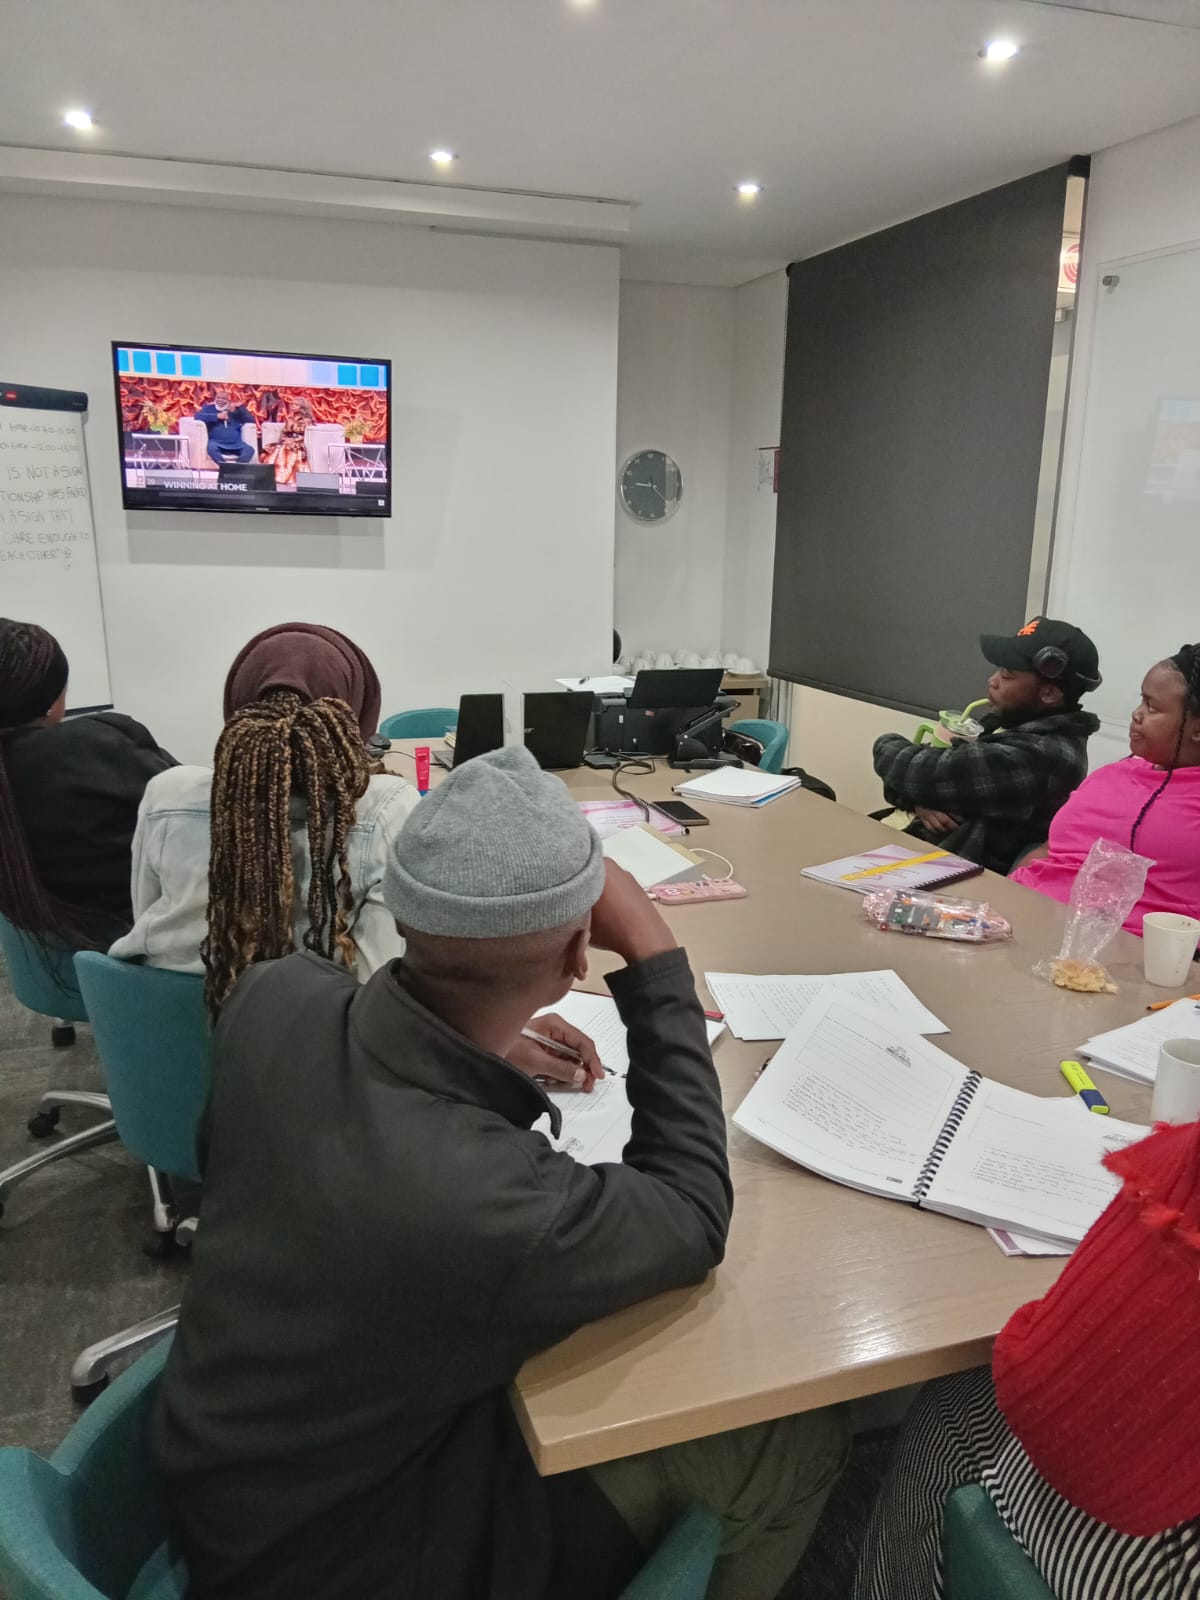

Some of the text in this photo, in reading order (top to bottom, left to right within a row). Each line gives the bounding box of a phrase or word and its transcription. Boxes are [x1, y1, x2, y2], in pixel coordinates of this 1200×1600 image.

[26, 465, 49, 480] NOT
[163, 480, 248, 492] WINNING AT HOME
